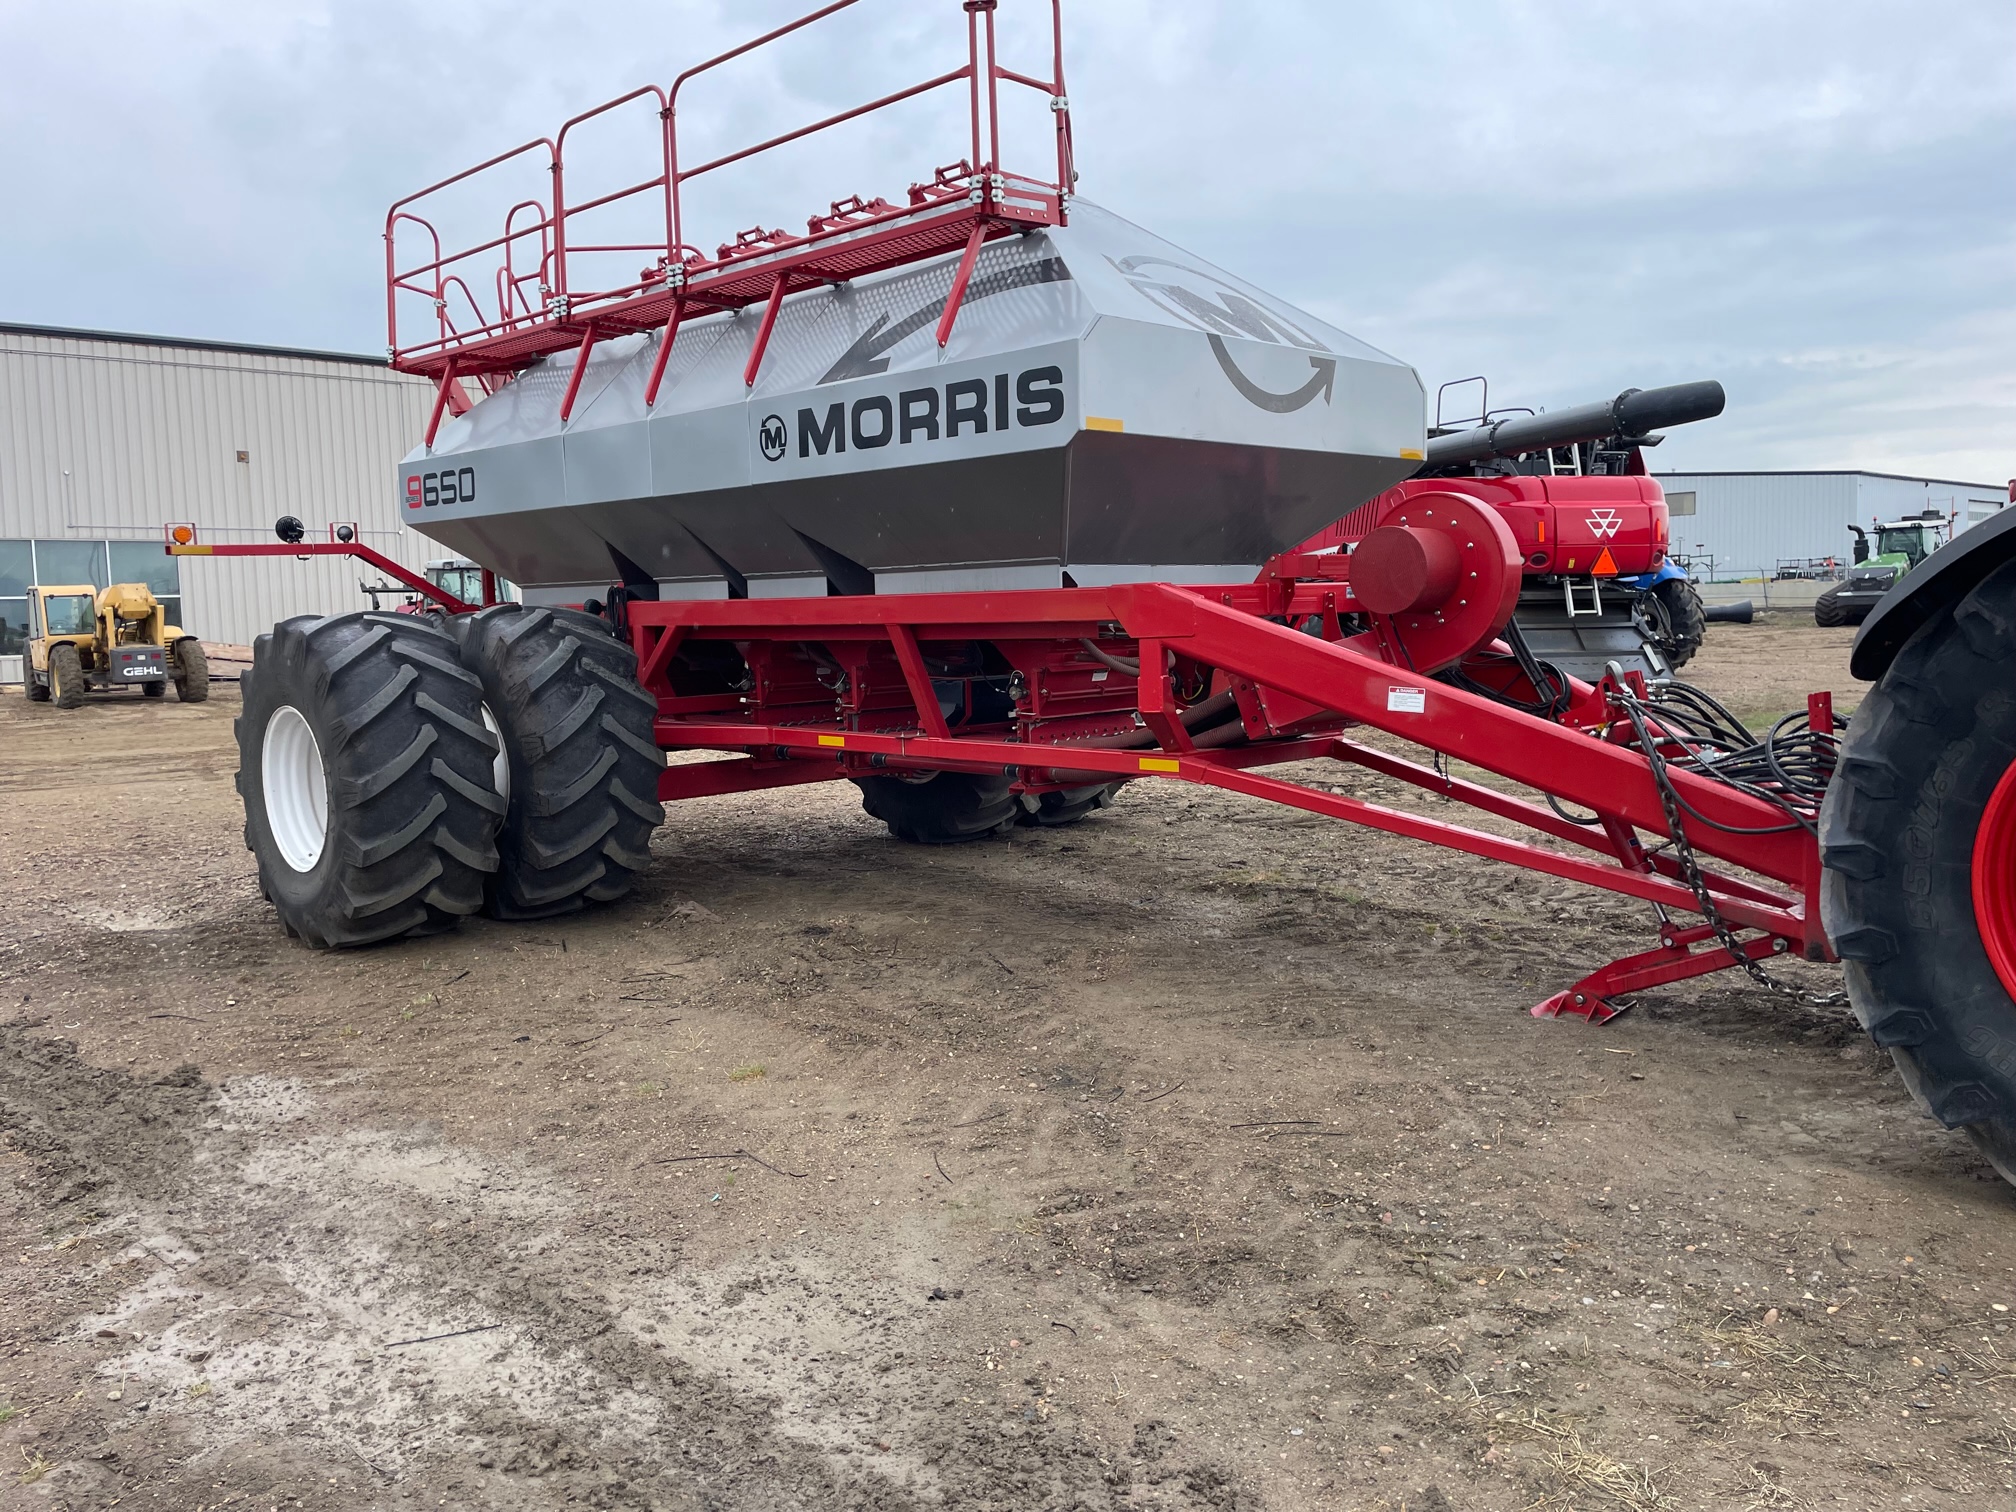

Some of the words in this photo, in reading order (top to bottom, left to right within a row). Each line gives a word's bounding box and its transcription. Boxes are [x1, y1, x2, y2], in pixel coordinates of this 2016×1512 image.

[797, 365, 1065, 458] MORRIS
[407, 466, 475, 509] 9650
[123, 665, 163, 676] GEHL
